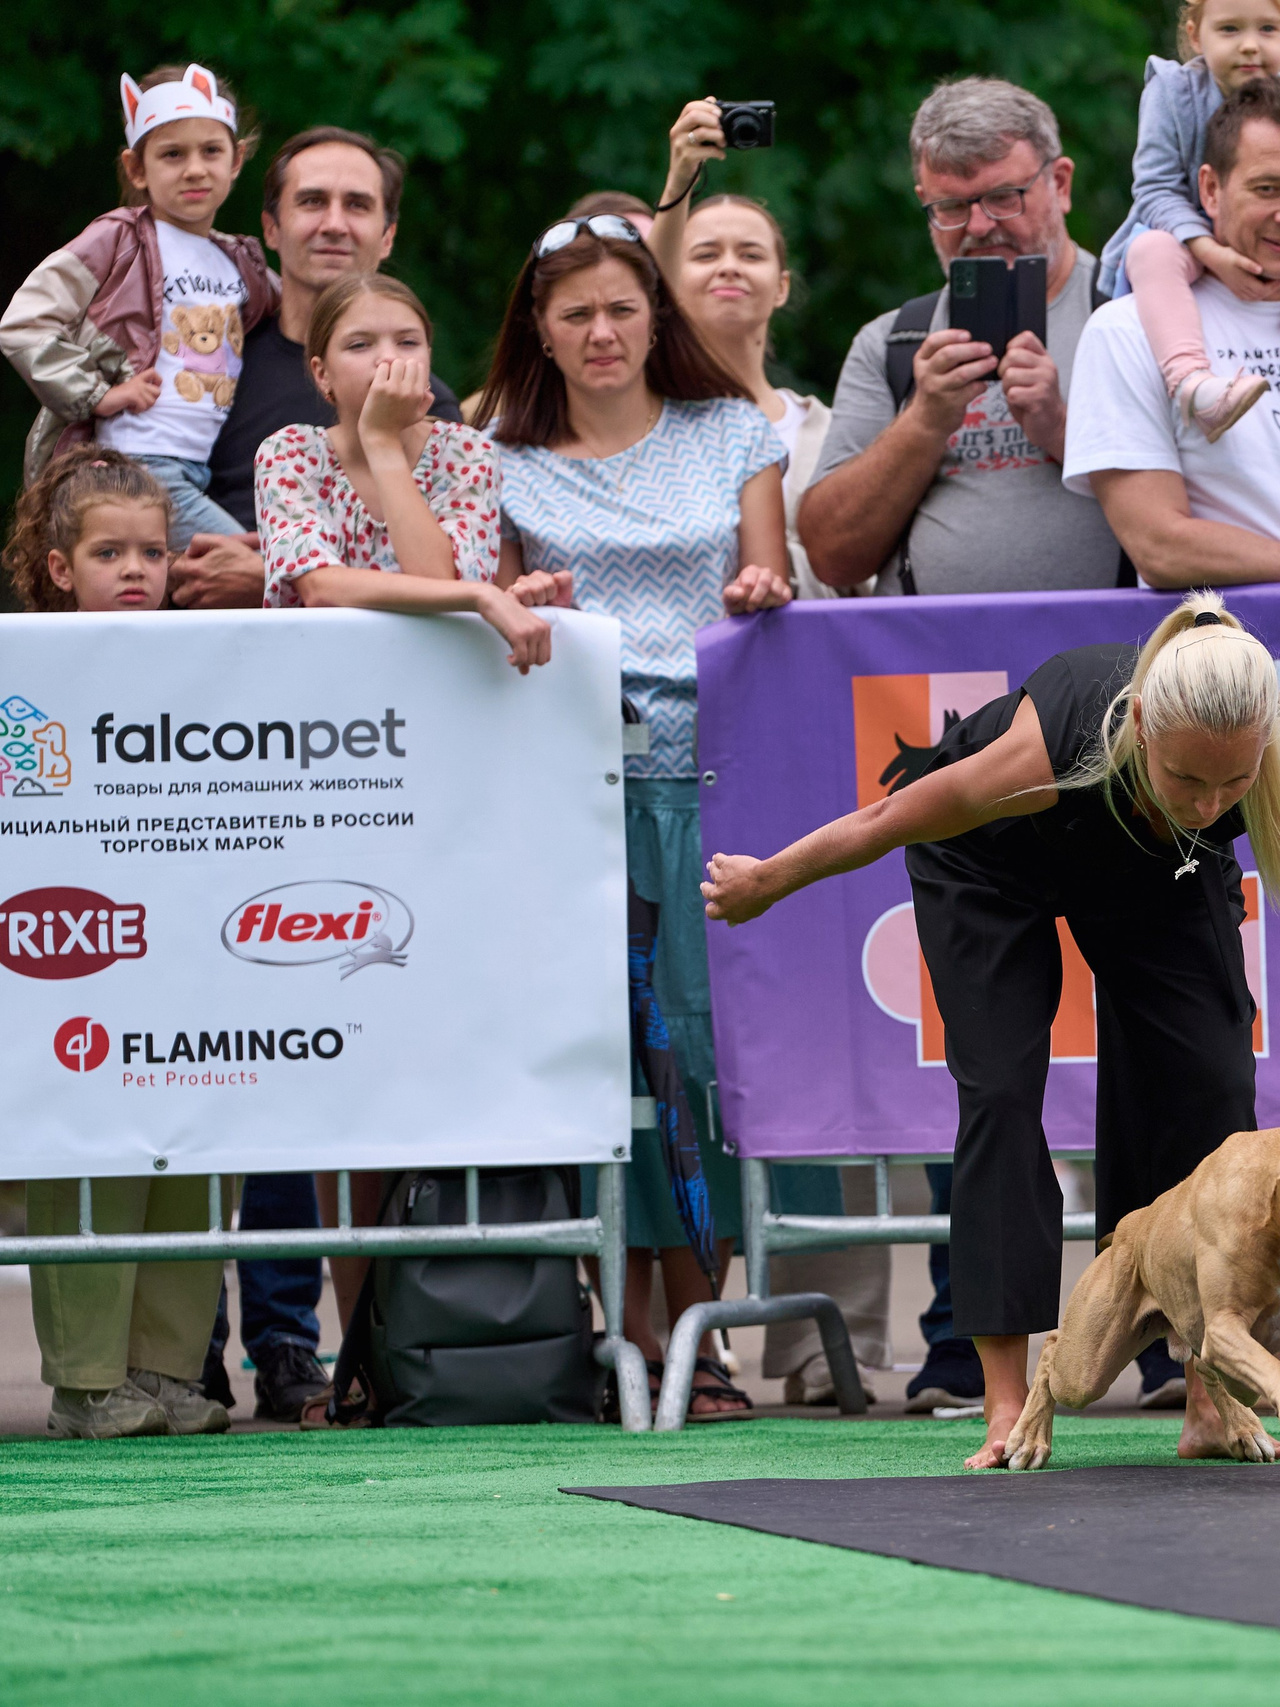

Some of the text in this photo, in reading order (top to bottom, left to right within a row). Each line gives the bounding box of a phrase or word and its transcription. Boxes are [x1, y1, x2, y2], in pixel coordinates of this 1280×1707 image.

[962, 428, 994, 447] IT'S
[956, 441, 1042, 462] TO LISTE
[91, 708, 406, 769] falconpet
[94, 777, 404, 797] товары для домашних животных
[0, 812, 414, 837] ИЦИАЛЬНЫЙ ПРЕДСТАВИТЕЛЬ В РОССИИ
[100, 835, 285, 853] ТОРГОВЫХ МАРОК
[122, 1027, 344, 1064] FLAMINGO
[123, 1070, 258, 1087] Pet Products
